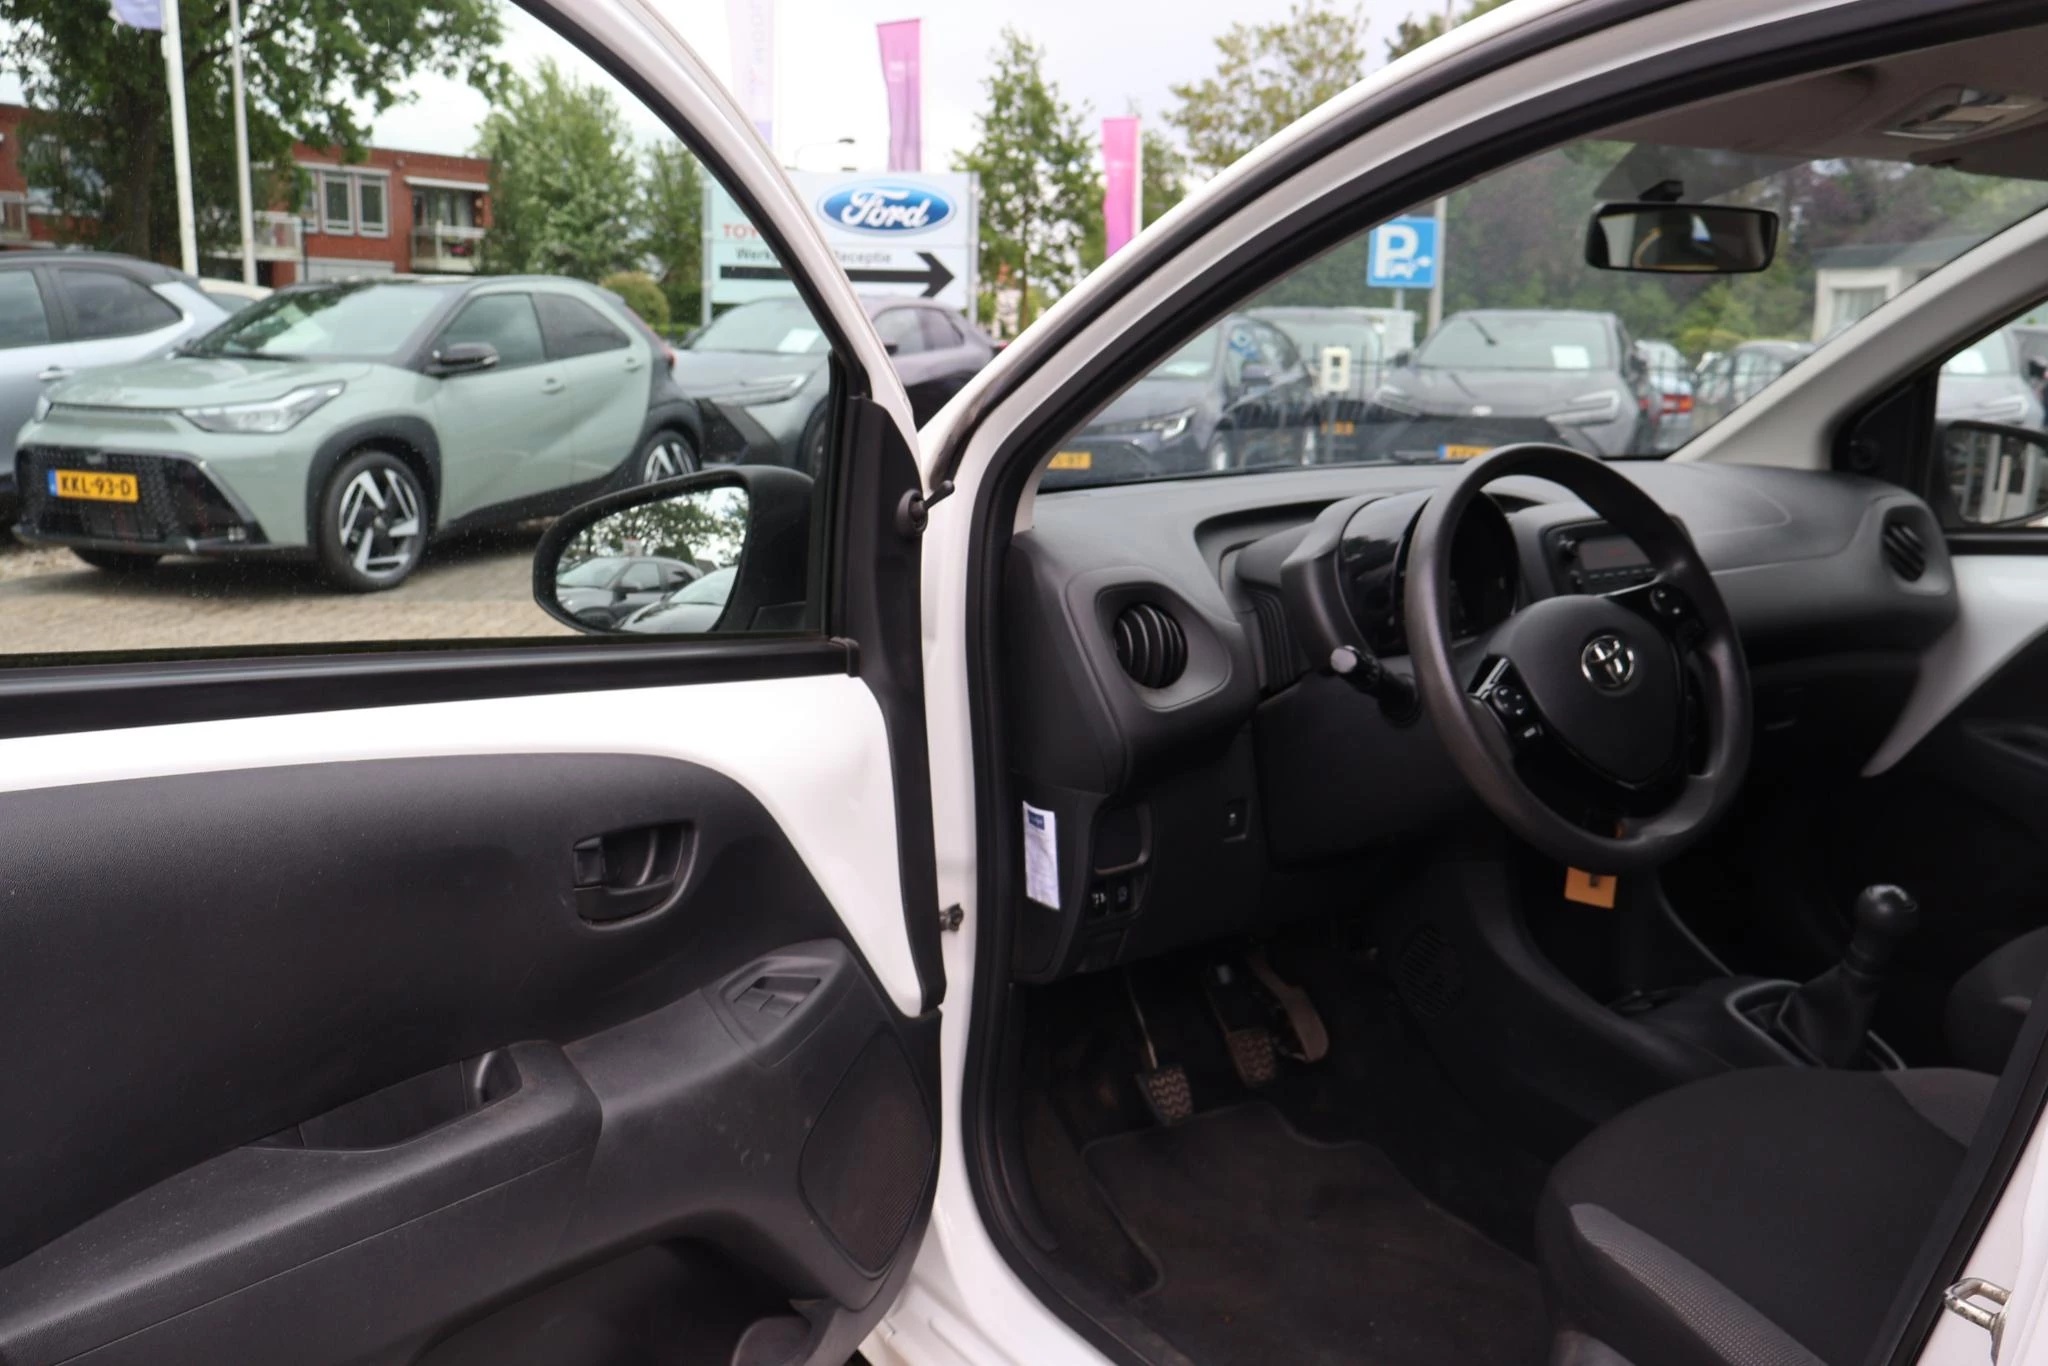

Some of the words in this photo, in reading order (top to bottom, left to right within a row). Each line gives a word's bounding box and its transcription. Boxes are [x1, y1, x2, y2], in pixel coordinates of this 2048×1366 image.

[841, 187, 931, 227] Ford
[723, 223, 759, 240] TOY
[1375, 224, 1419, 278] P
[61, 475, 131, 496] KKL-93-D
